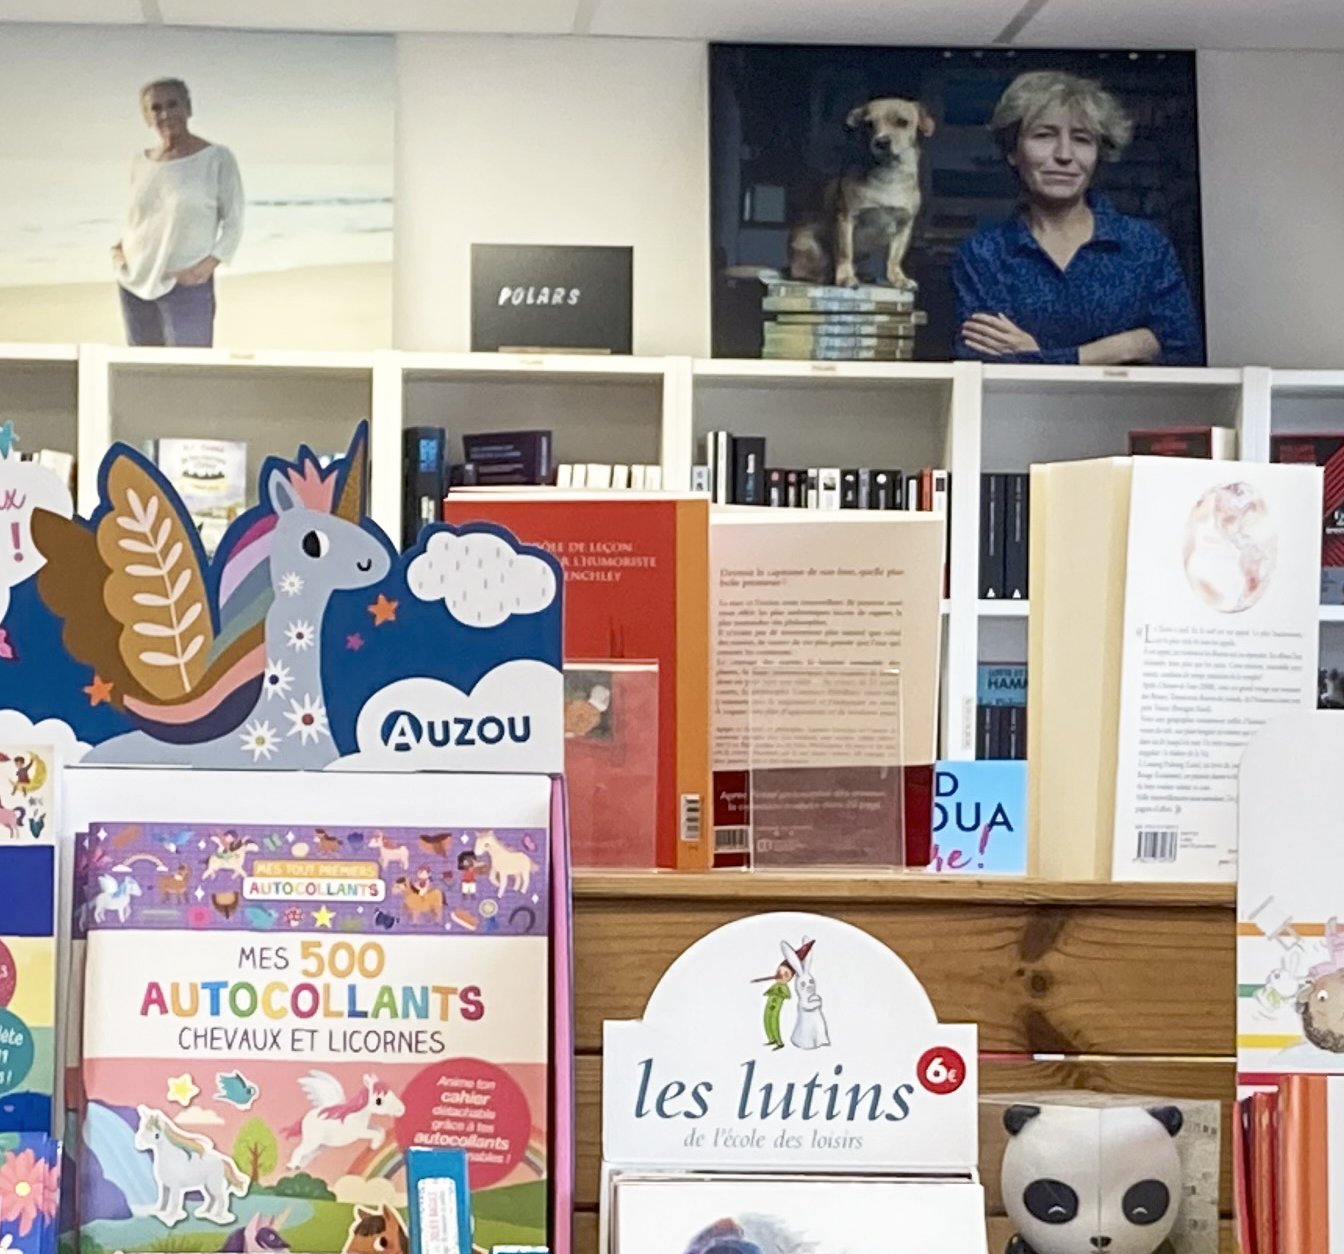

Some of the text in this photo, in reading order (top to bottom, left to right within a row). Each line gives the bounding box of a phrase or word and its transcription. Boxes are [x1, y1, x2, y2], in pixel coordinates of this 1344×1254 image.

[497, 286, 581, 306] POLARS
[248, 880, 380, 898] AUTOCOLLANTS
[238, 940, 386, 979] MES 500
[139, 980, 486, 1021] AUTOCOLLANTS
[178, 1027, 446, 1055] CHEVAUX ET LICORNES
[633, 1057, 915, 1123] les lutins
[413, 1132, 510, 1151] autocollants
[683, 1126, 864, 1151] de l'école des loisirs
